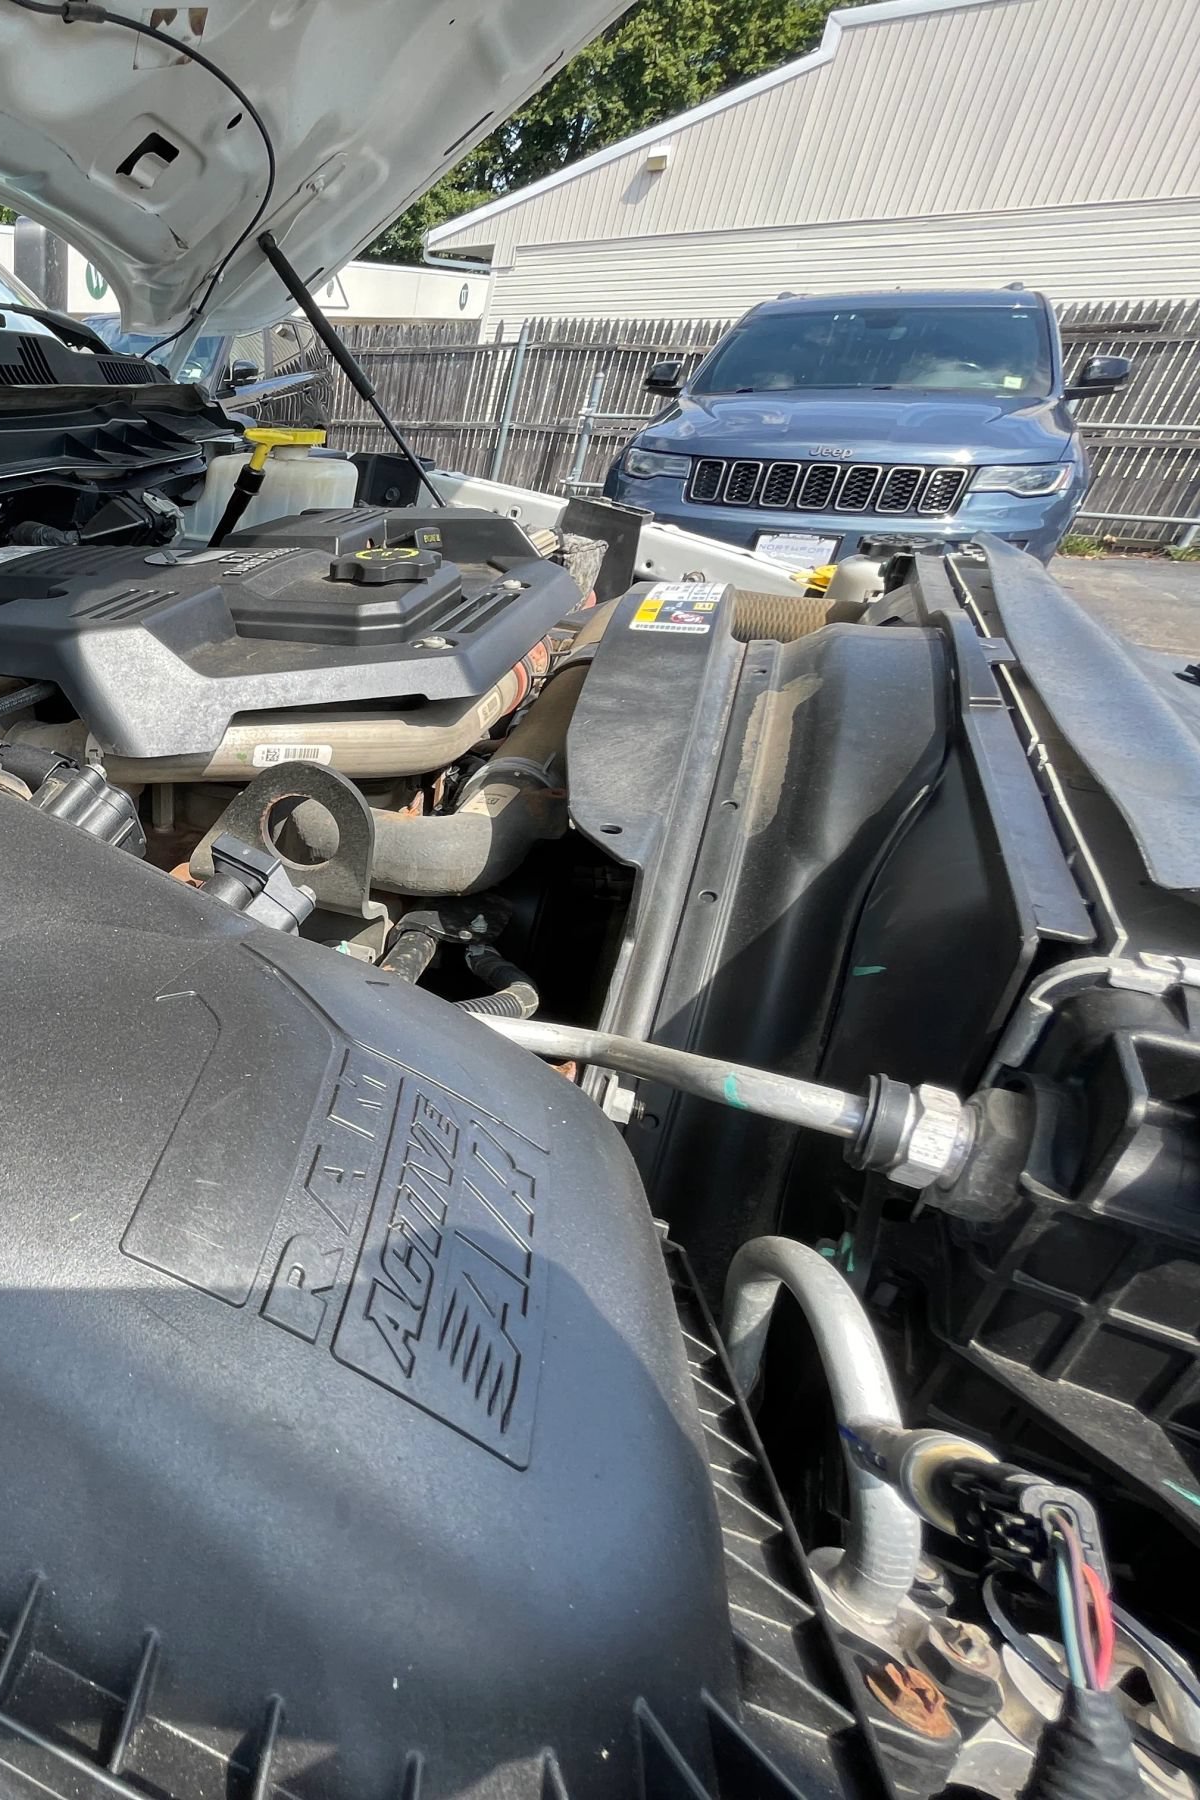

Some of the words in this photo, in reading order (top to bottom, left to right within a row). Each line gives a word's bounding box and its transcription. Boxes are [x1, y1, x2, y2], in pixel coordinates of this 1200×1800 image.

[809, 445, 854, 460] Jeep
[258, 1047, 389, 1345] RAM
[363, 1088, 461, 1378] ACTIVE
[438, 1119, 537, 1434] AIR
